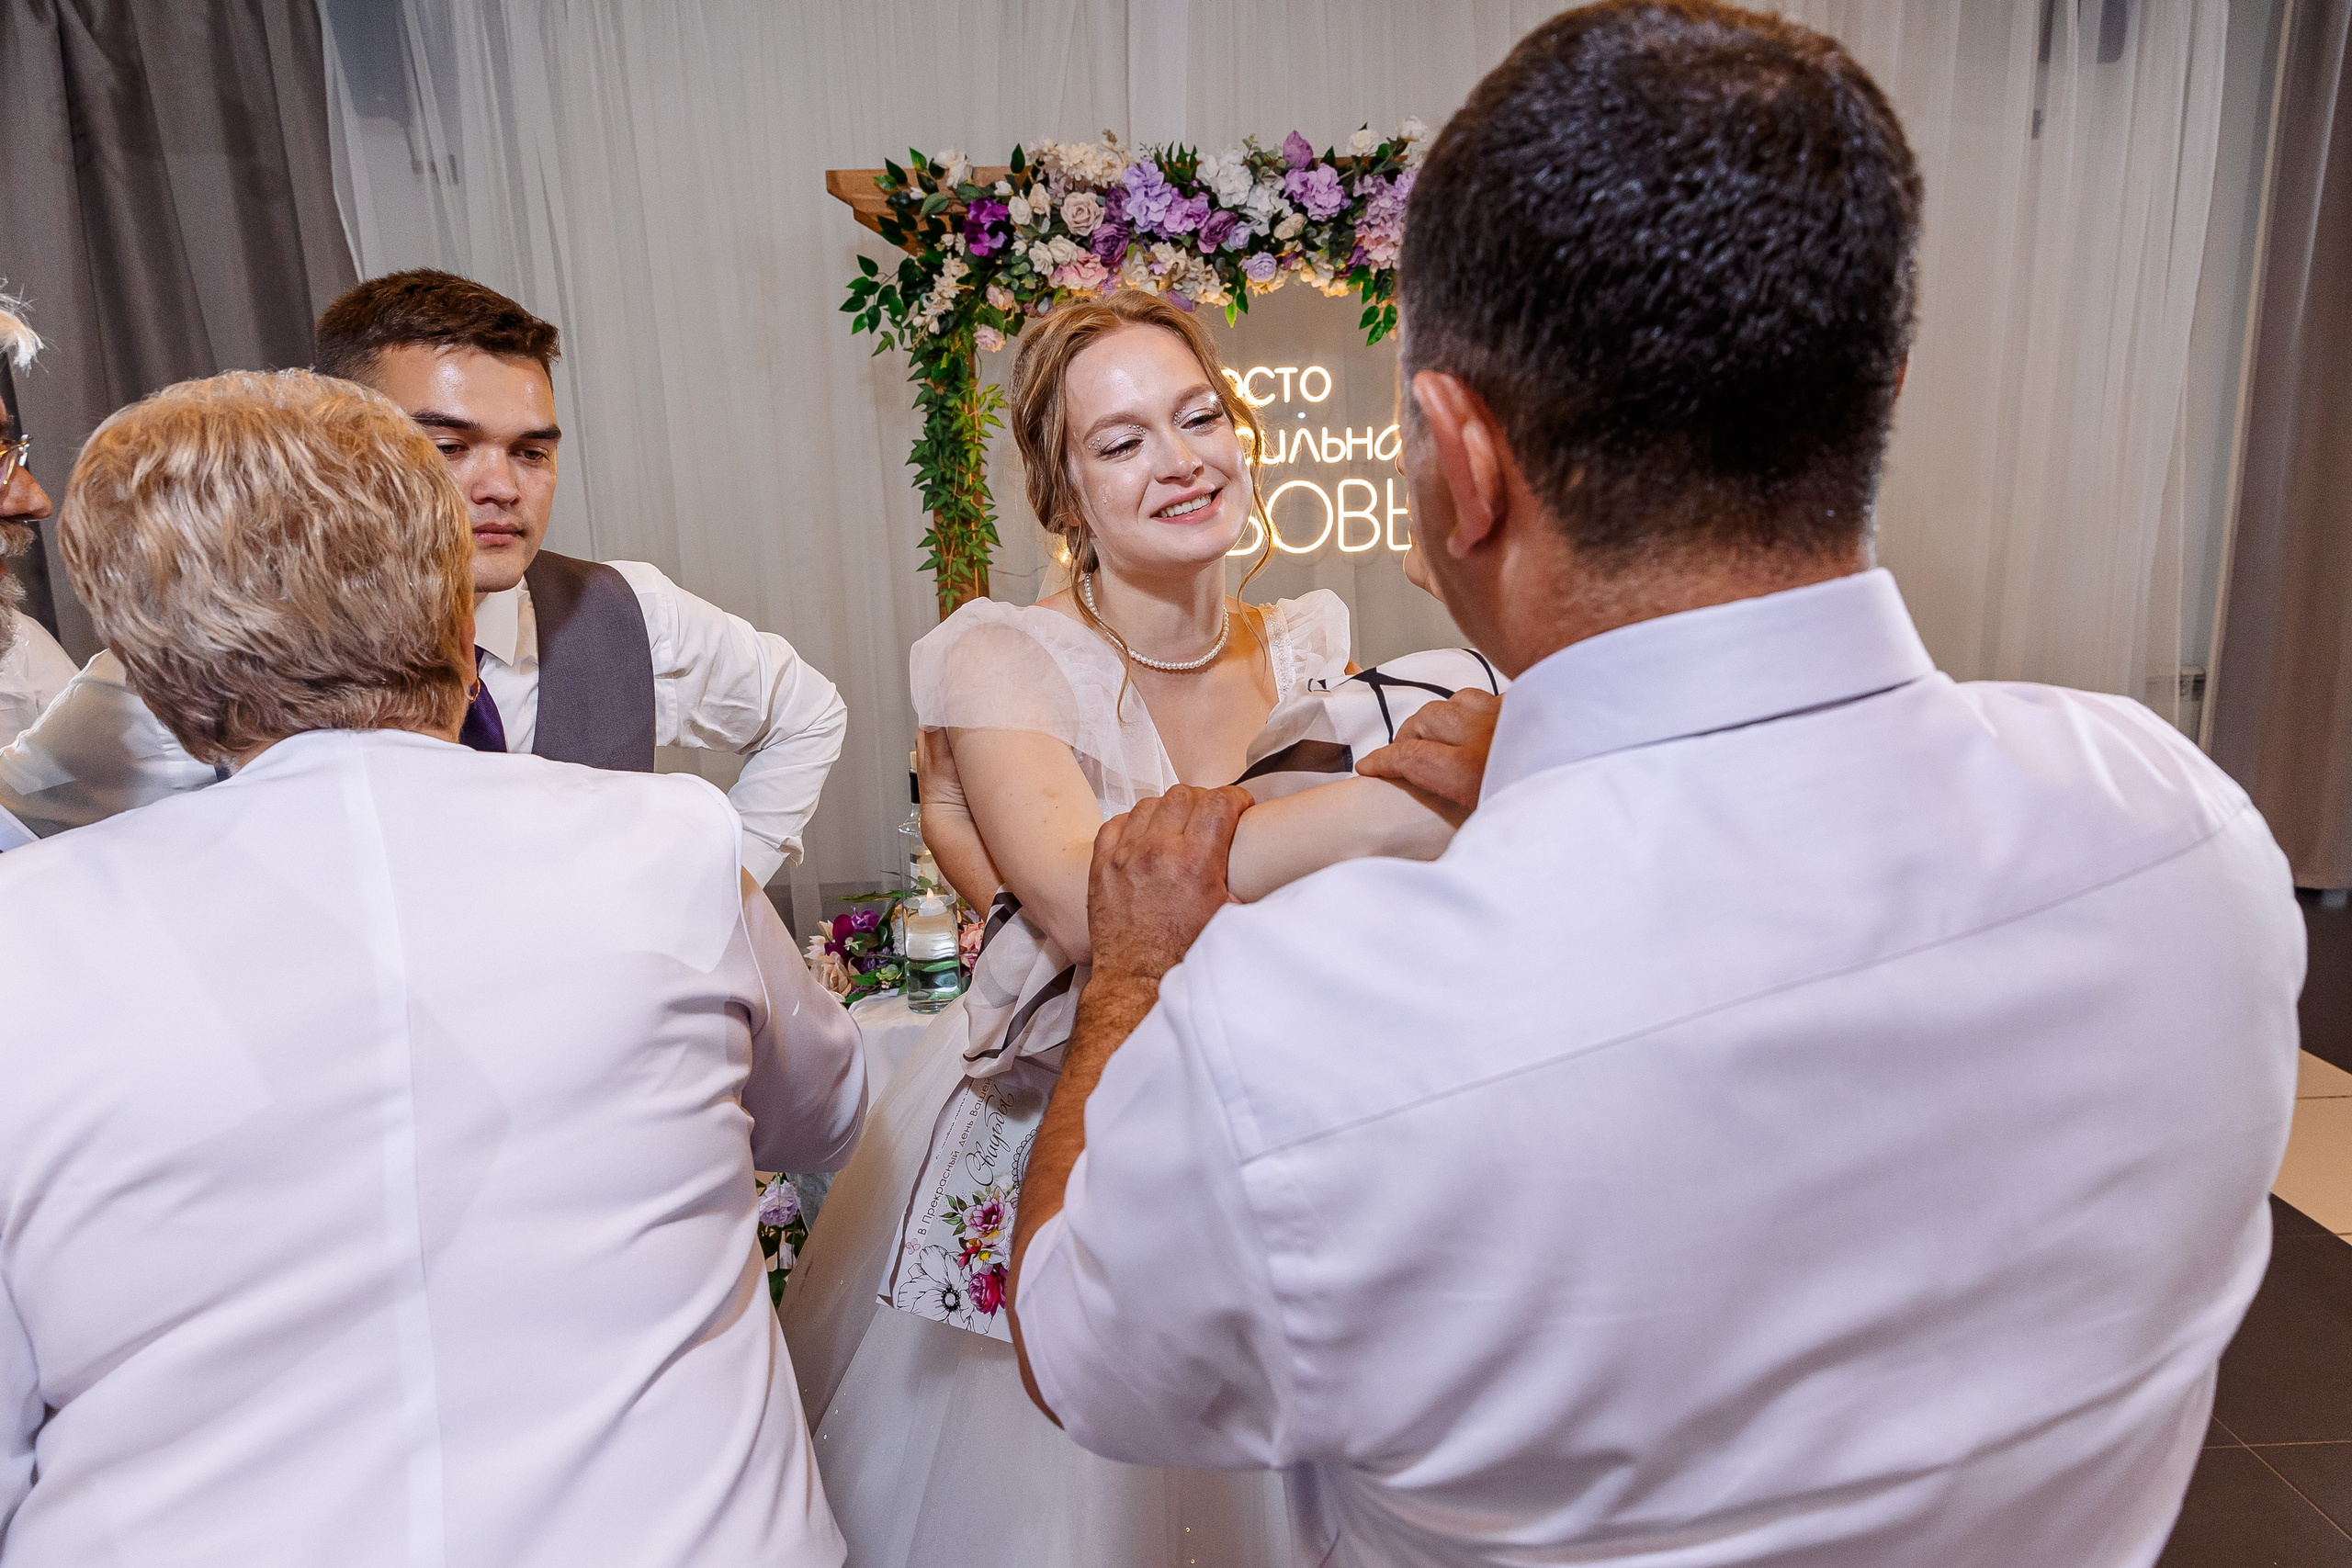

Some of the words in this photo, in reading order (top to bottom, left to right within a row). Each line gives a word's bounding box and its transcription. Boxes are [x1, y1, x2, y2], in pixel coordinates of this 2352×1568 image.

[917, 1227, 927, 1235] В
[922, 1150, 960, 1224] Прекрасный
[958, 1120, 975, 1147] день
[965, 1083, 1015, 1187] Свадьбы
